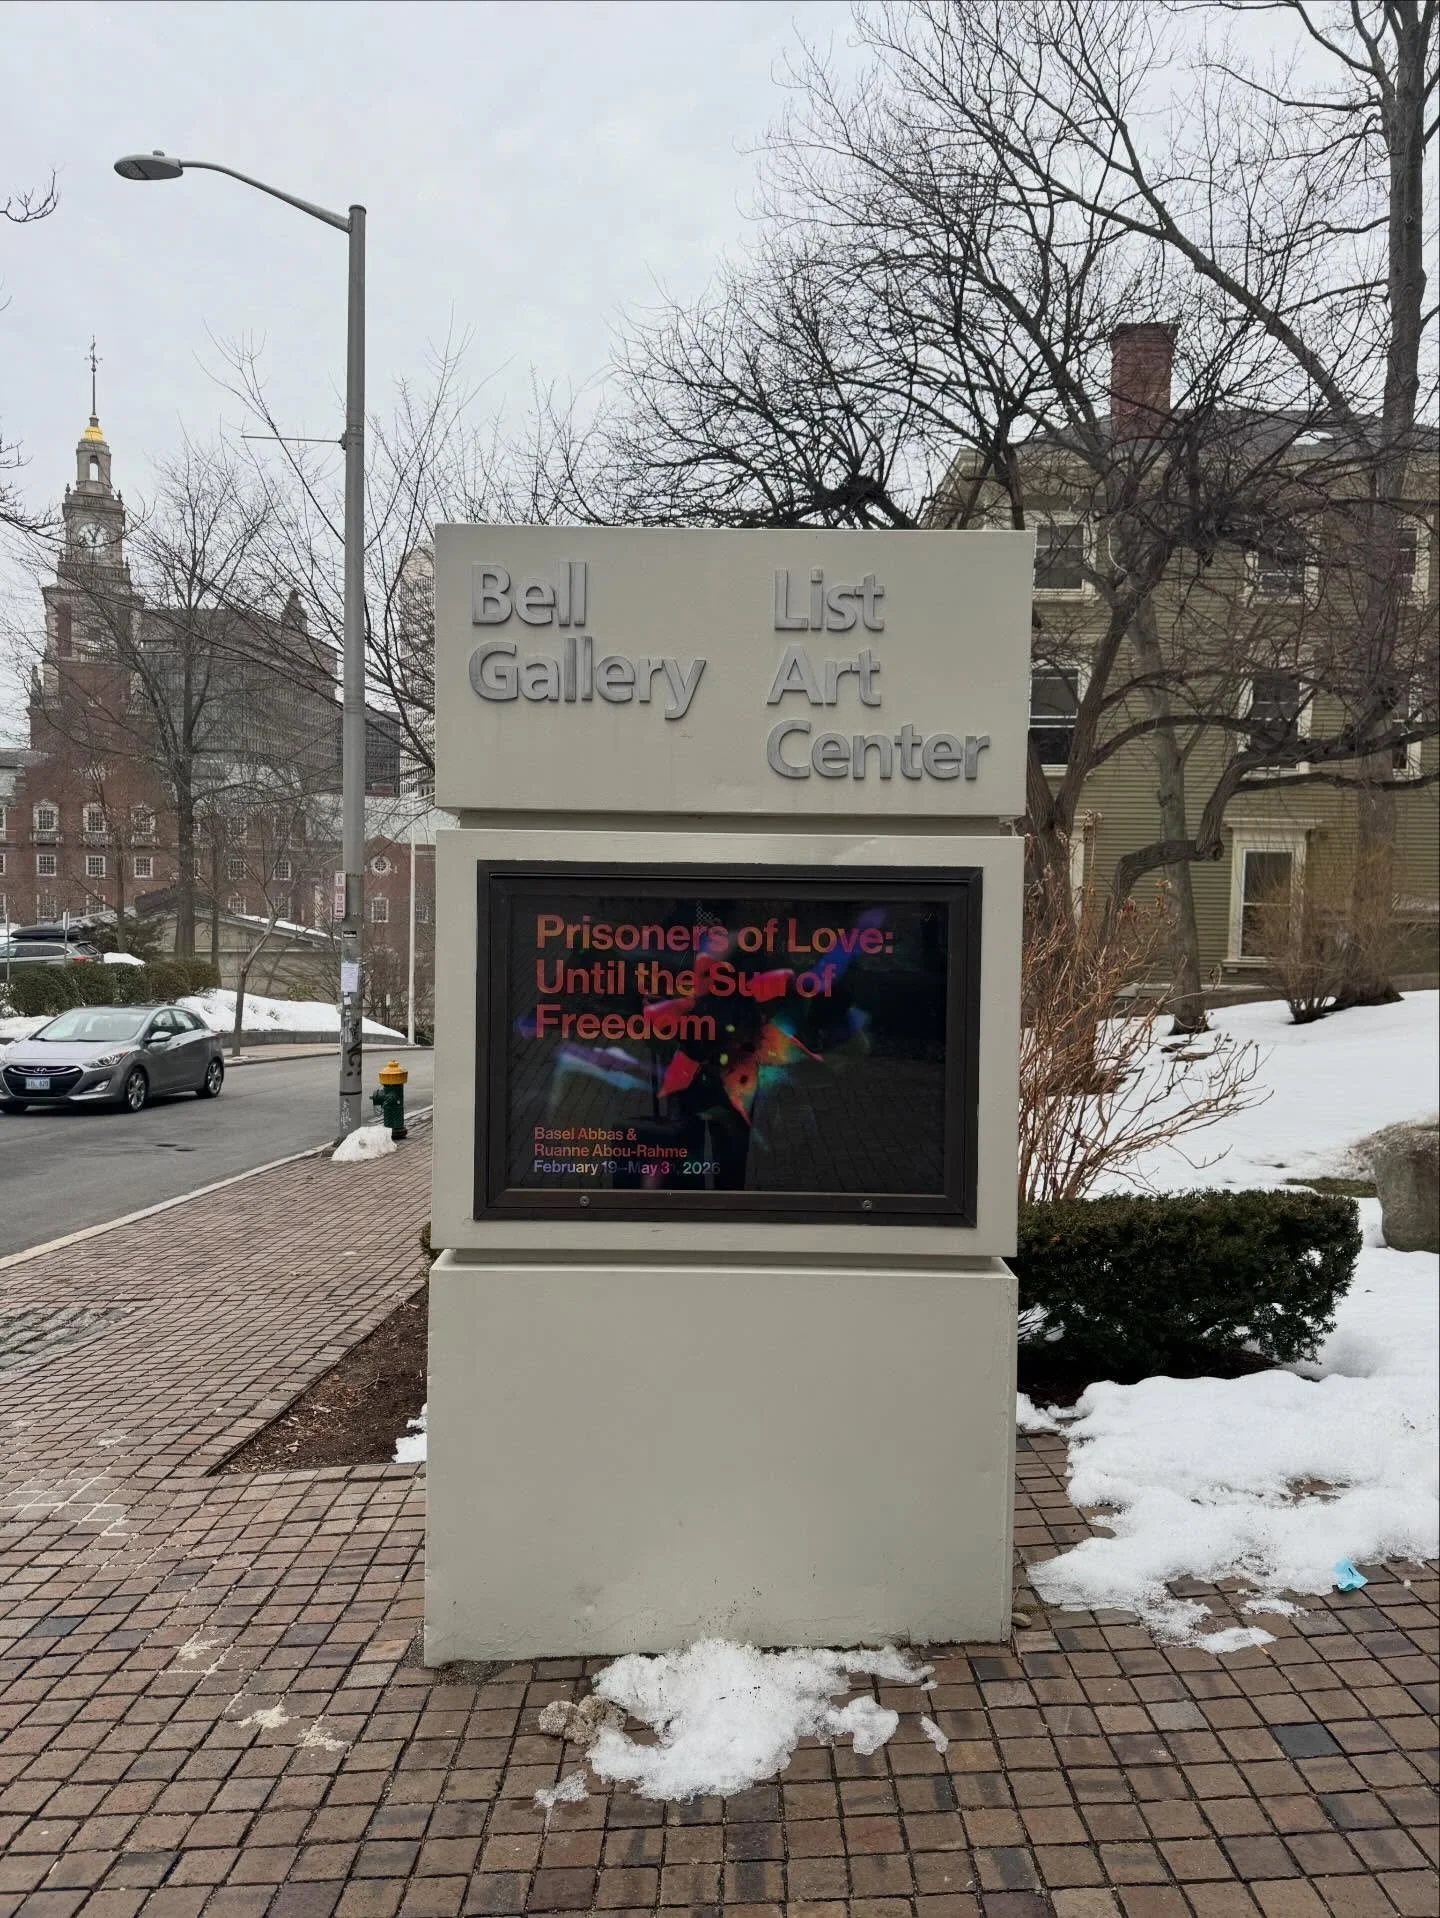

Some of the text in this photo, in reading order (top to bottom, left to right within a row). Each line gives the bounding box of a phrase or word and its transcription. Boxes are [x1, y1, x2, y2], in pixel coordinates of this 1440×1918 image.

[472, 561, 587, 626] Bell
[774, 567, 885, 632] List
[468, 635, 706, 719] Gallery
[766, 645, 881, 706] Art
[766, 718, 989, 780] Center
[535, 914, 894, 954] Prisoners of Love:
[535, 959, 838, 998] Until the Sun of
[535, 1003, 716, 1041] Freedom
[534, 1127, 638, 1141] Basel Abbas &
[534, 1143, 688, 1158] Ruanne Abou-Rahme
[533, 1160, 598, 1176] February
[682, 1162, 721, 1175] 2026
